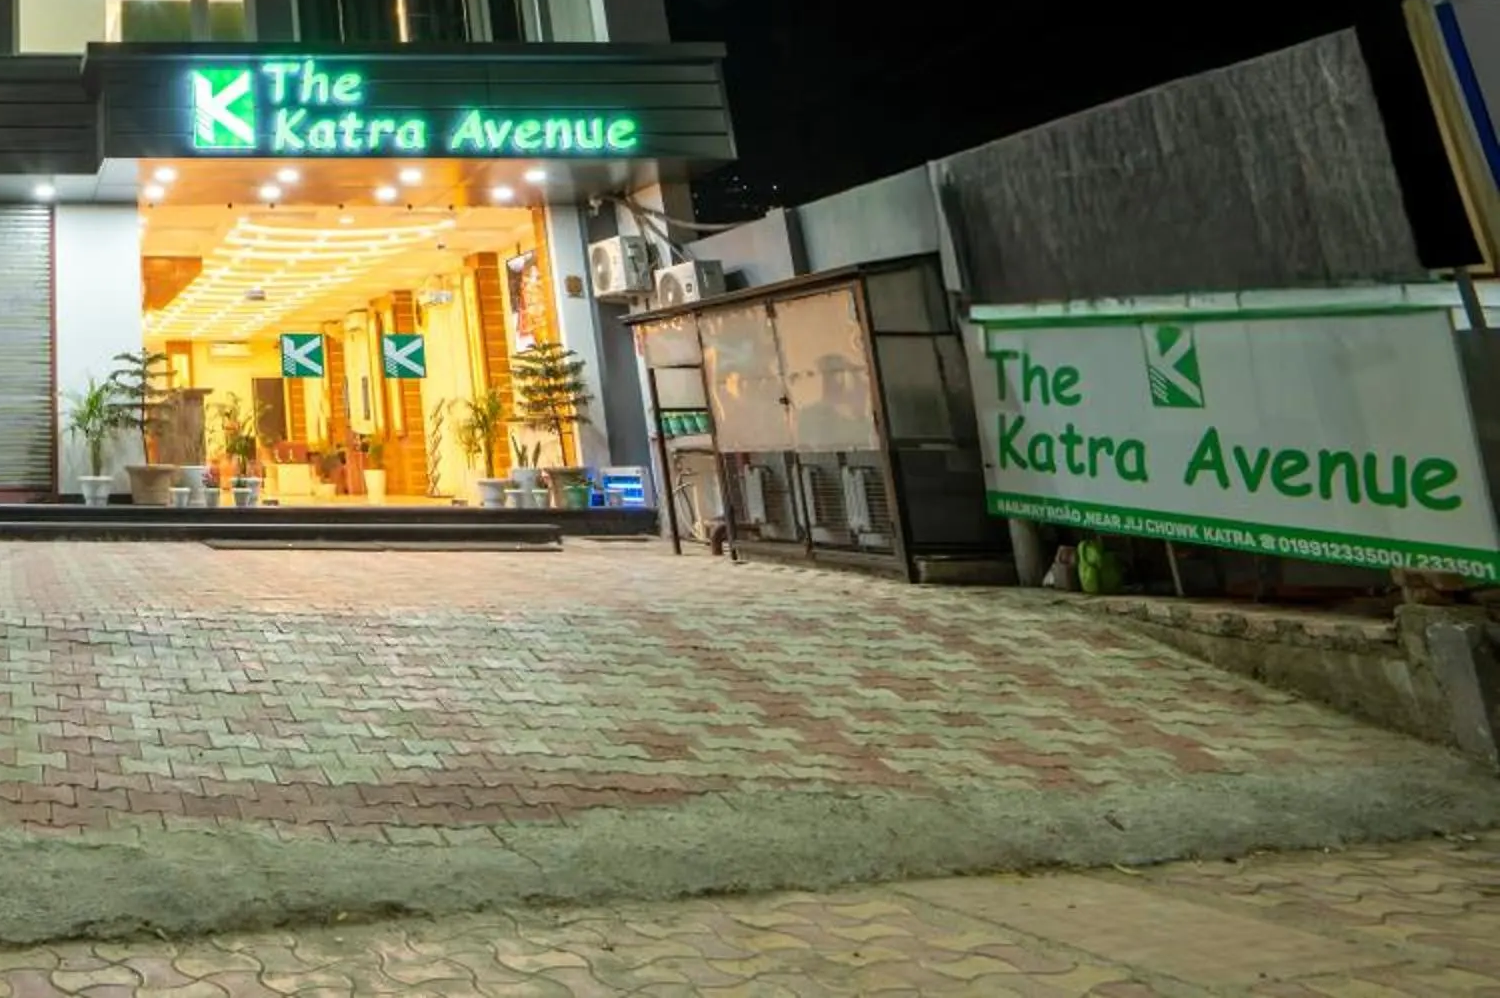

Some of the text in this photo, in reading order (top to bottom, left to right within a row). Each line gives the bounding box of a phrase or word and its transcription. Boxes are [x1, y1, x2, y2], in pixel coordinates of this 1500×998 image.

[263, 62, 362, 103] The
[276, 109, 637, 151] Katra Avenue
[986, 349, 1082, 405] The
[998, 414, 1463, 511] Katra Avenue
[1145, 520, 1199, 539] CHOWK
[1203, 525, 1256, 547] KATRA
